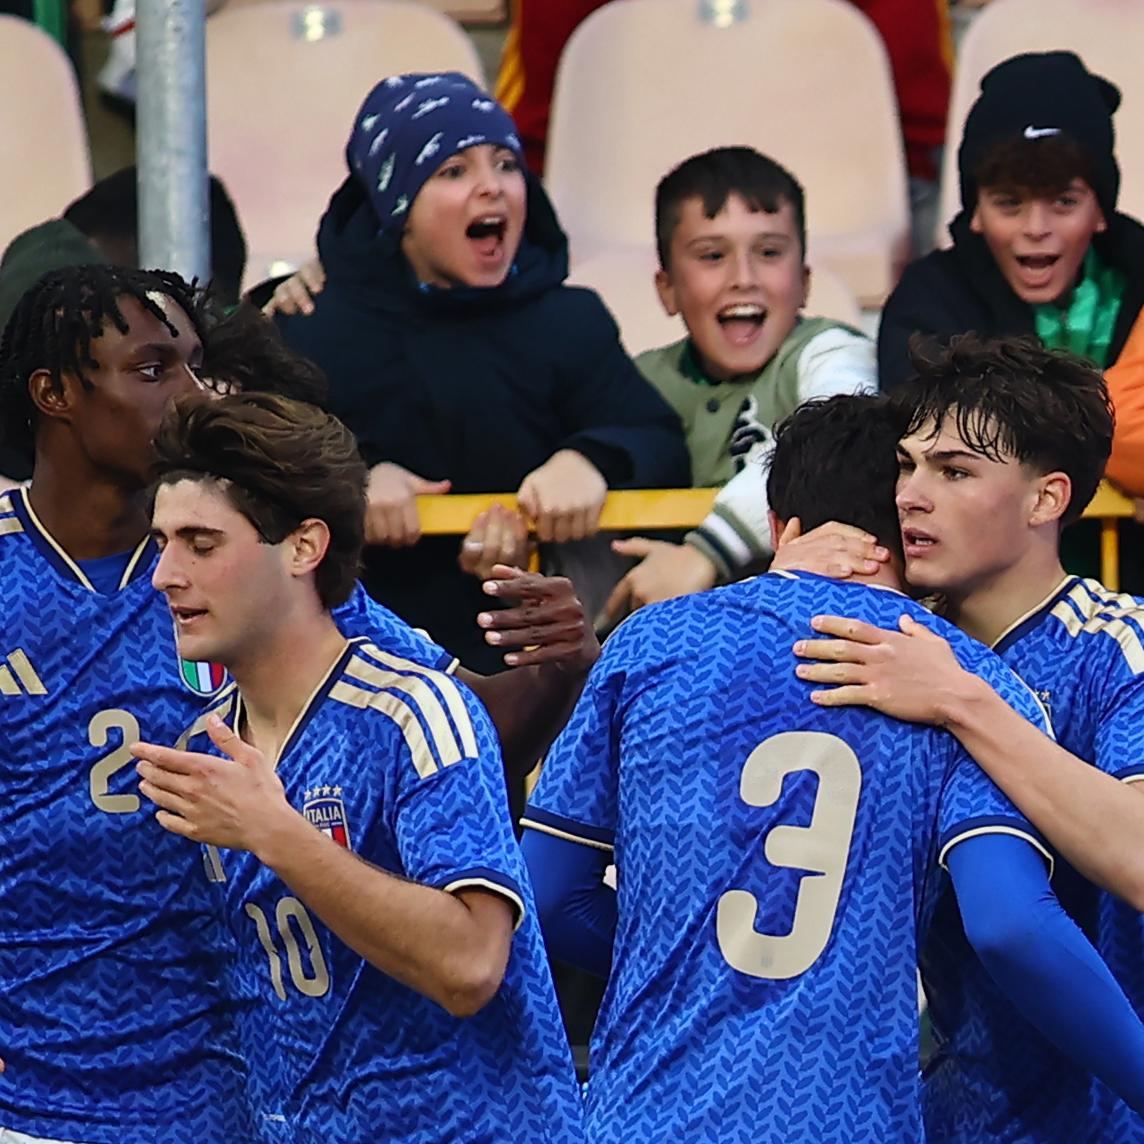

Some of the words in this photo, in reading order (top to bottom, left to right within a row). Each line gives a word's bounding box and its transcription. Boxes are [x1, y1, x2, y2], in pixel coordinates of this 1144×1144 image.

[88, 708, 140, 813] 2
[306, 805, 342, 823] ITALIA
[716, 731, 862, 979] 3
[245, 896, 330, 1001] 10
